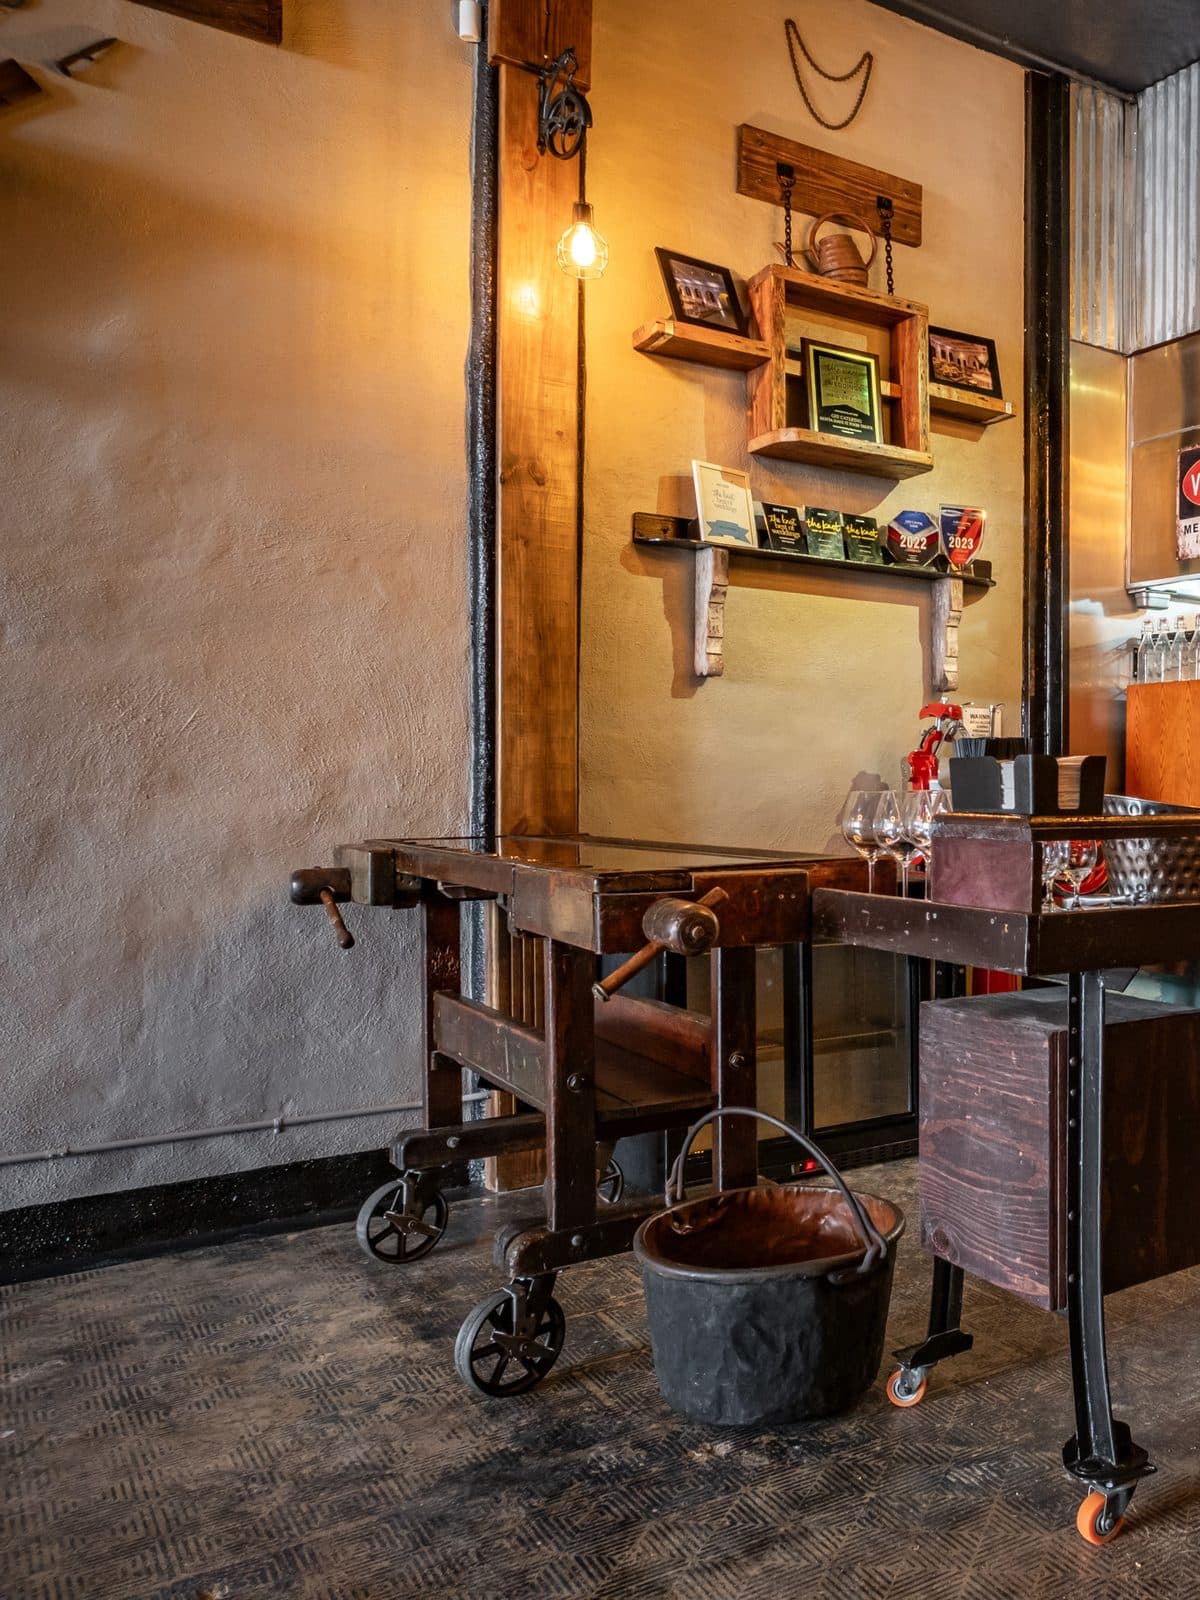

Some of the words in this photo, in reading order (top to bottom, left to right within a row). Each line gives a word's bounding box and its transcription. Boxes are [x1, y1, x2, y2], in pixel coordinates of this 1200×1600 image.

[806, 517, 820, 529] the
[821, 520, 841, 532] knot
[845, 523, 860, 535] the
[860, 527, 879, 538] knot
[900, 534, 927, 550] 2022
[948, 536, 974, 549] 2023
